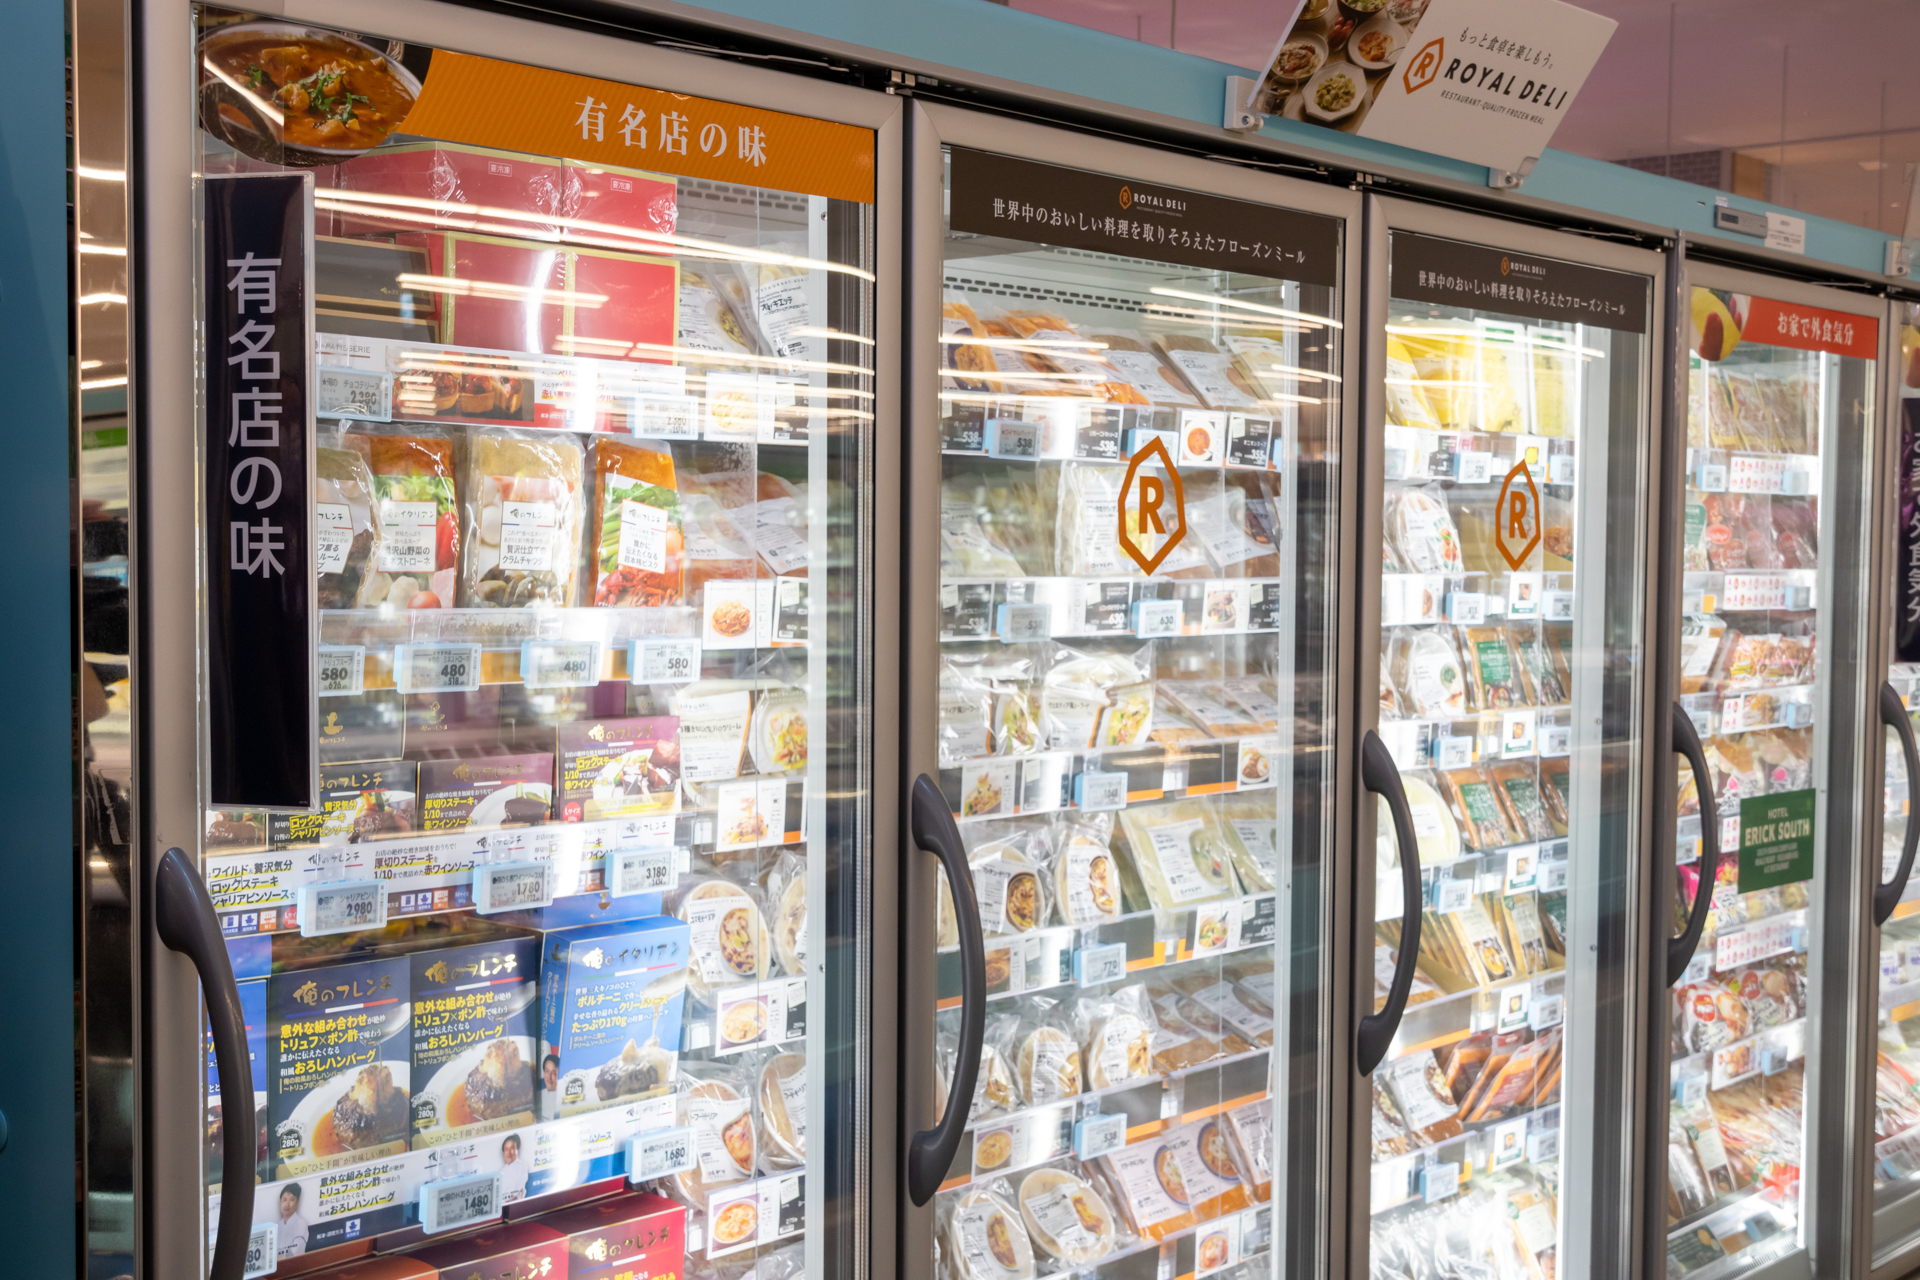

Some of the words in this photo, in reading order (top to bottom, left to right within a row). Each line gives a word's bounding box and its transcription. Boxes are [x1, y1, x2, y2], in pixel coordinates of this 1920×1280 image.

[1460, 26, 1554, 70] もっと食卓を楽しもう。
[1444, 58, 1513, 96] ROYAL
[1518, 80, 1568, 110] DELI
[1440, 90, 1505, 115] RESTAURANT-QUALITY
[1505, 106, 1529, 121] FROZEN
[1530, 115, 1544, 125] MEAL
[574, 95, 768, 168] 有名店の味
[1133, 193, 1163, 207] ROYAL
[1166, 199, 1187, 211] DELI
[992, 198, 1306, 265] 世界中のおいしい料理を取りそろえたフローズンミール
[1510, 262, 1531, 273] ROYAL
[1532, 265, 1546, 275] DELI
[1418, 270, 1626, 316] 世界中のおいしい料理を取りそろえたフローズンミール
[1777, 312, 1854, 346] お家で外食気分
[227, 251, 285, 579] 有名店の味
[1139, 476, 1167, 534] R
[1509, 490, 1528, 539] R
[507, 545, 547, 555] 贅沢仕立ての
[625, 547, 658, 561] 伝えたくなる
[633, 539, 651, 549] 誰かに
[624, 555, 659, 570] 超本格ビスク
[321, 667, 348, 681] 580
[441, 664, 466, 677] 480
[564, 661, 587, 673] 480
[668, 658, 689, 669] 580
[588, 723, 653, 742] 俺のフレンチ
[453, 762, 523, 781] 俺のフレンチ
[1767, 807, 1789, 819] HOTEL
[1744, 823, 1776, 846] ERICK
[1777, 818, 1810, 840] SOUTH
[374, 852, 439, 869] 厚切りステーキを
[375, 843, 457, 857] お店の絶妙な焼き加減をおうちで!
[582, 942, 679, 970] 俺のイタリアン
[425, 954, 517, 985] 俺のフレンチ
[292, 975, 392, 1006] 俺のフレンチ
[575, 981, 636, 996] 世界三大キノコのひとつ
[414, 991, 512, 1015] 意外な組み合わせが絶妙
[280, 1013, 386, 1038] 意外な組み合わせが絶妙
[414, 1005, 508, 1028] トリュフ×ポン酢で味わう
[280, 1029, 382, 1053] トリュフ×ポン酢で味わう
[414, 1023, 470, 1038] 誰かに伝えたくなる
[414, 1024, 504, 1051] 和風おろしハンバーグ
[280, 1045, 340, 1063] 誰かに伝えたくなる
[280, 1049, 377, 1077] 和風おろしハンバーグ
[417, 1109, 434, 1119] 280g
[281, 1139, 299, 1148] 280g
[319, 1175, 401, 1199] トリュフ×ポン酢で味わう
[320, 1163, 405, 1188] 意外な組み合わせが絶妙
[319, 1191, 366, 1207] 誰かに伝えたくなる
[319, 1191, 396, 1218] 和風おろしハンバーグ
[585, 1226, 670, 1261] 俺のフレンチ
